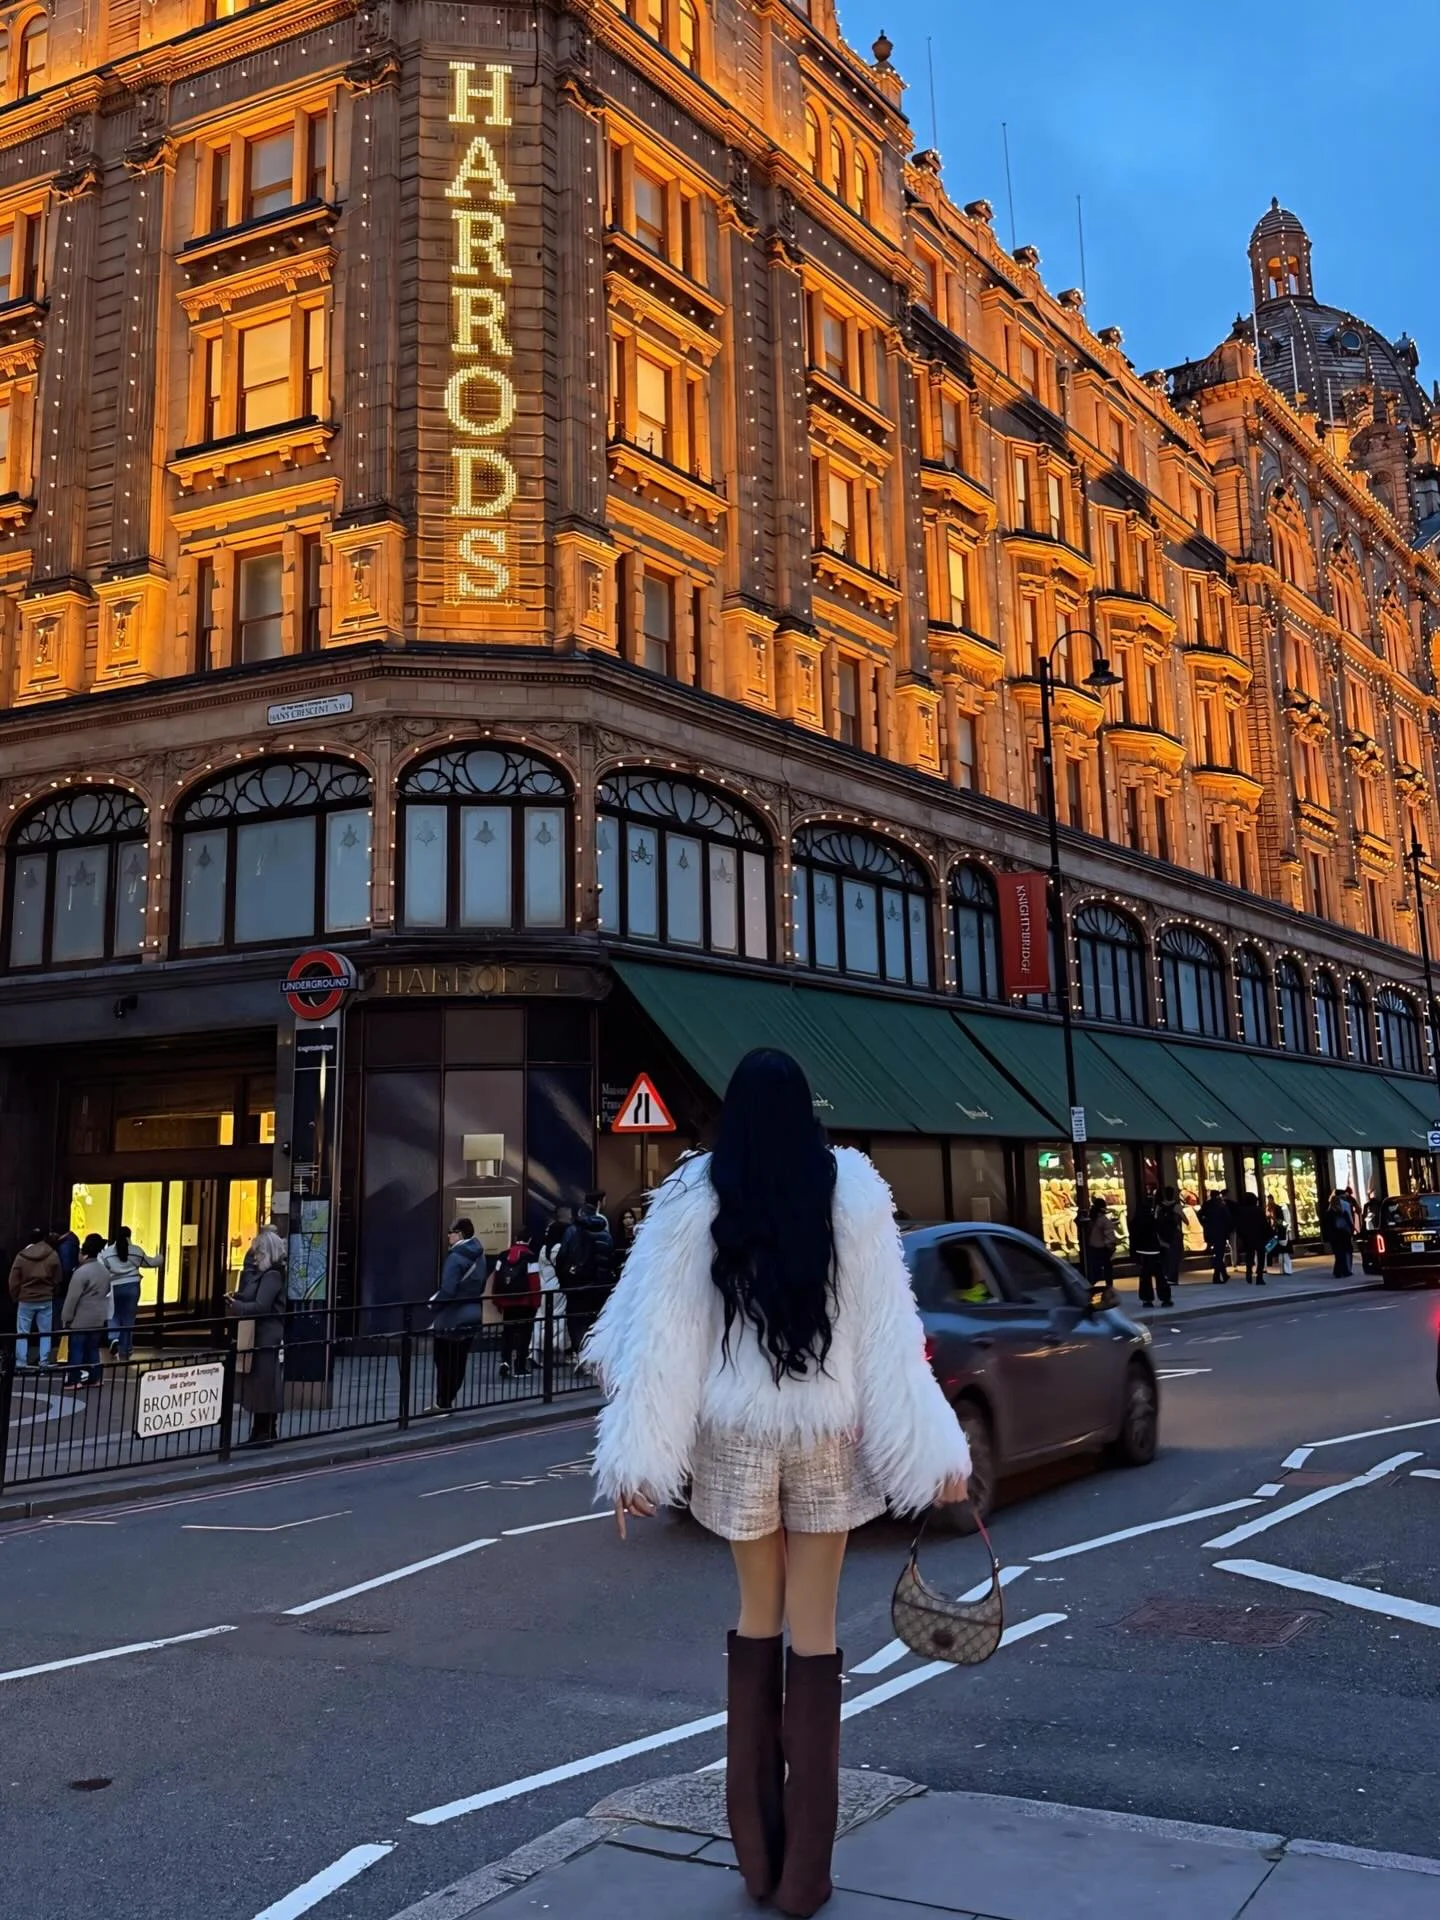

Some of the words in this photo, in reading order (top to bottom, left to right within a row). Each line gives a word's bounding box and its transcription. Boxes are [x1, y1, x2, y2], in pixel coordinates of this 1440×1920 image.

[444, 61, 517, 598] HARRODS
[281, 977, 349, 991] UNDERGROUND
[143, 1387, 219, 1413] BROMPTON
